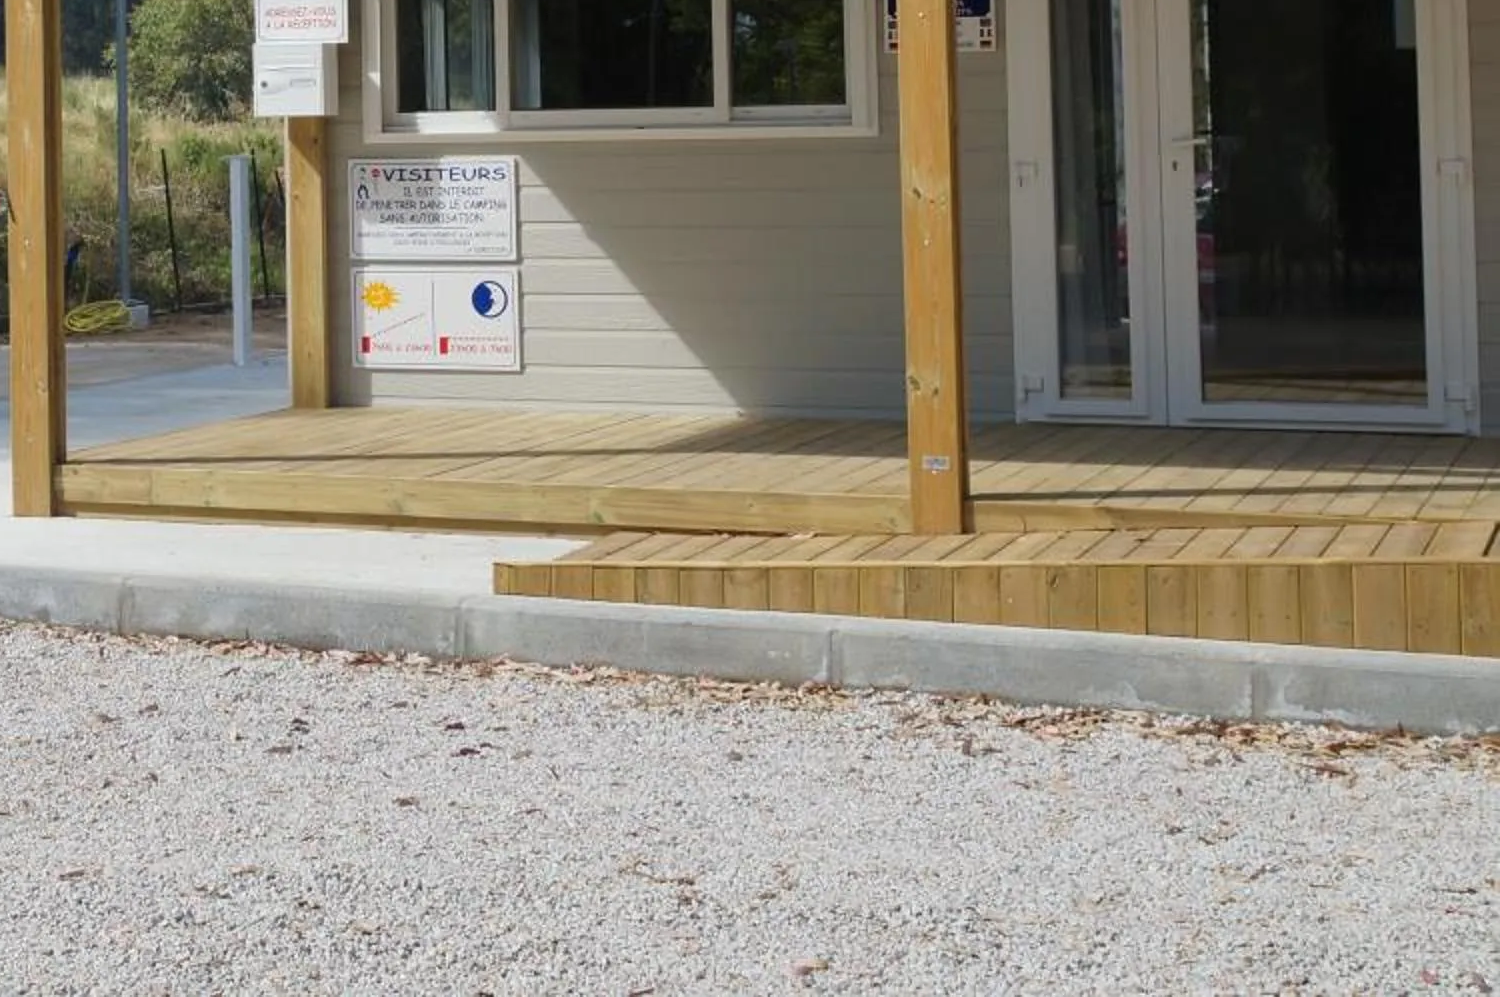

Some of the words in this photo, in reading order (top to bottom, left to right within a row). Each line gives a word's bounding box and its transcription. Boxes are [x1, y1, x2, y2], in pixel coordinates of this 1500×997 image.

[383, 167, 506, 182] VISITEURS
[403, 187, 414, 197] IL
[416, 187, 433, 197] EST
[420, 200, 446, 210] DANS
[449, 200, 461, 210] LE
[464, 199, 508, 210] CAMPING
[379, 214, 405, 224] SANS
[409, 213, 484, 224] AUTORISATION
